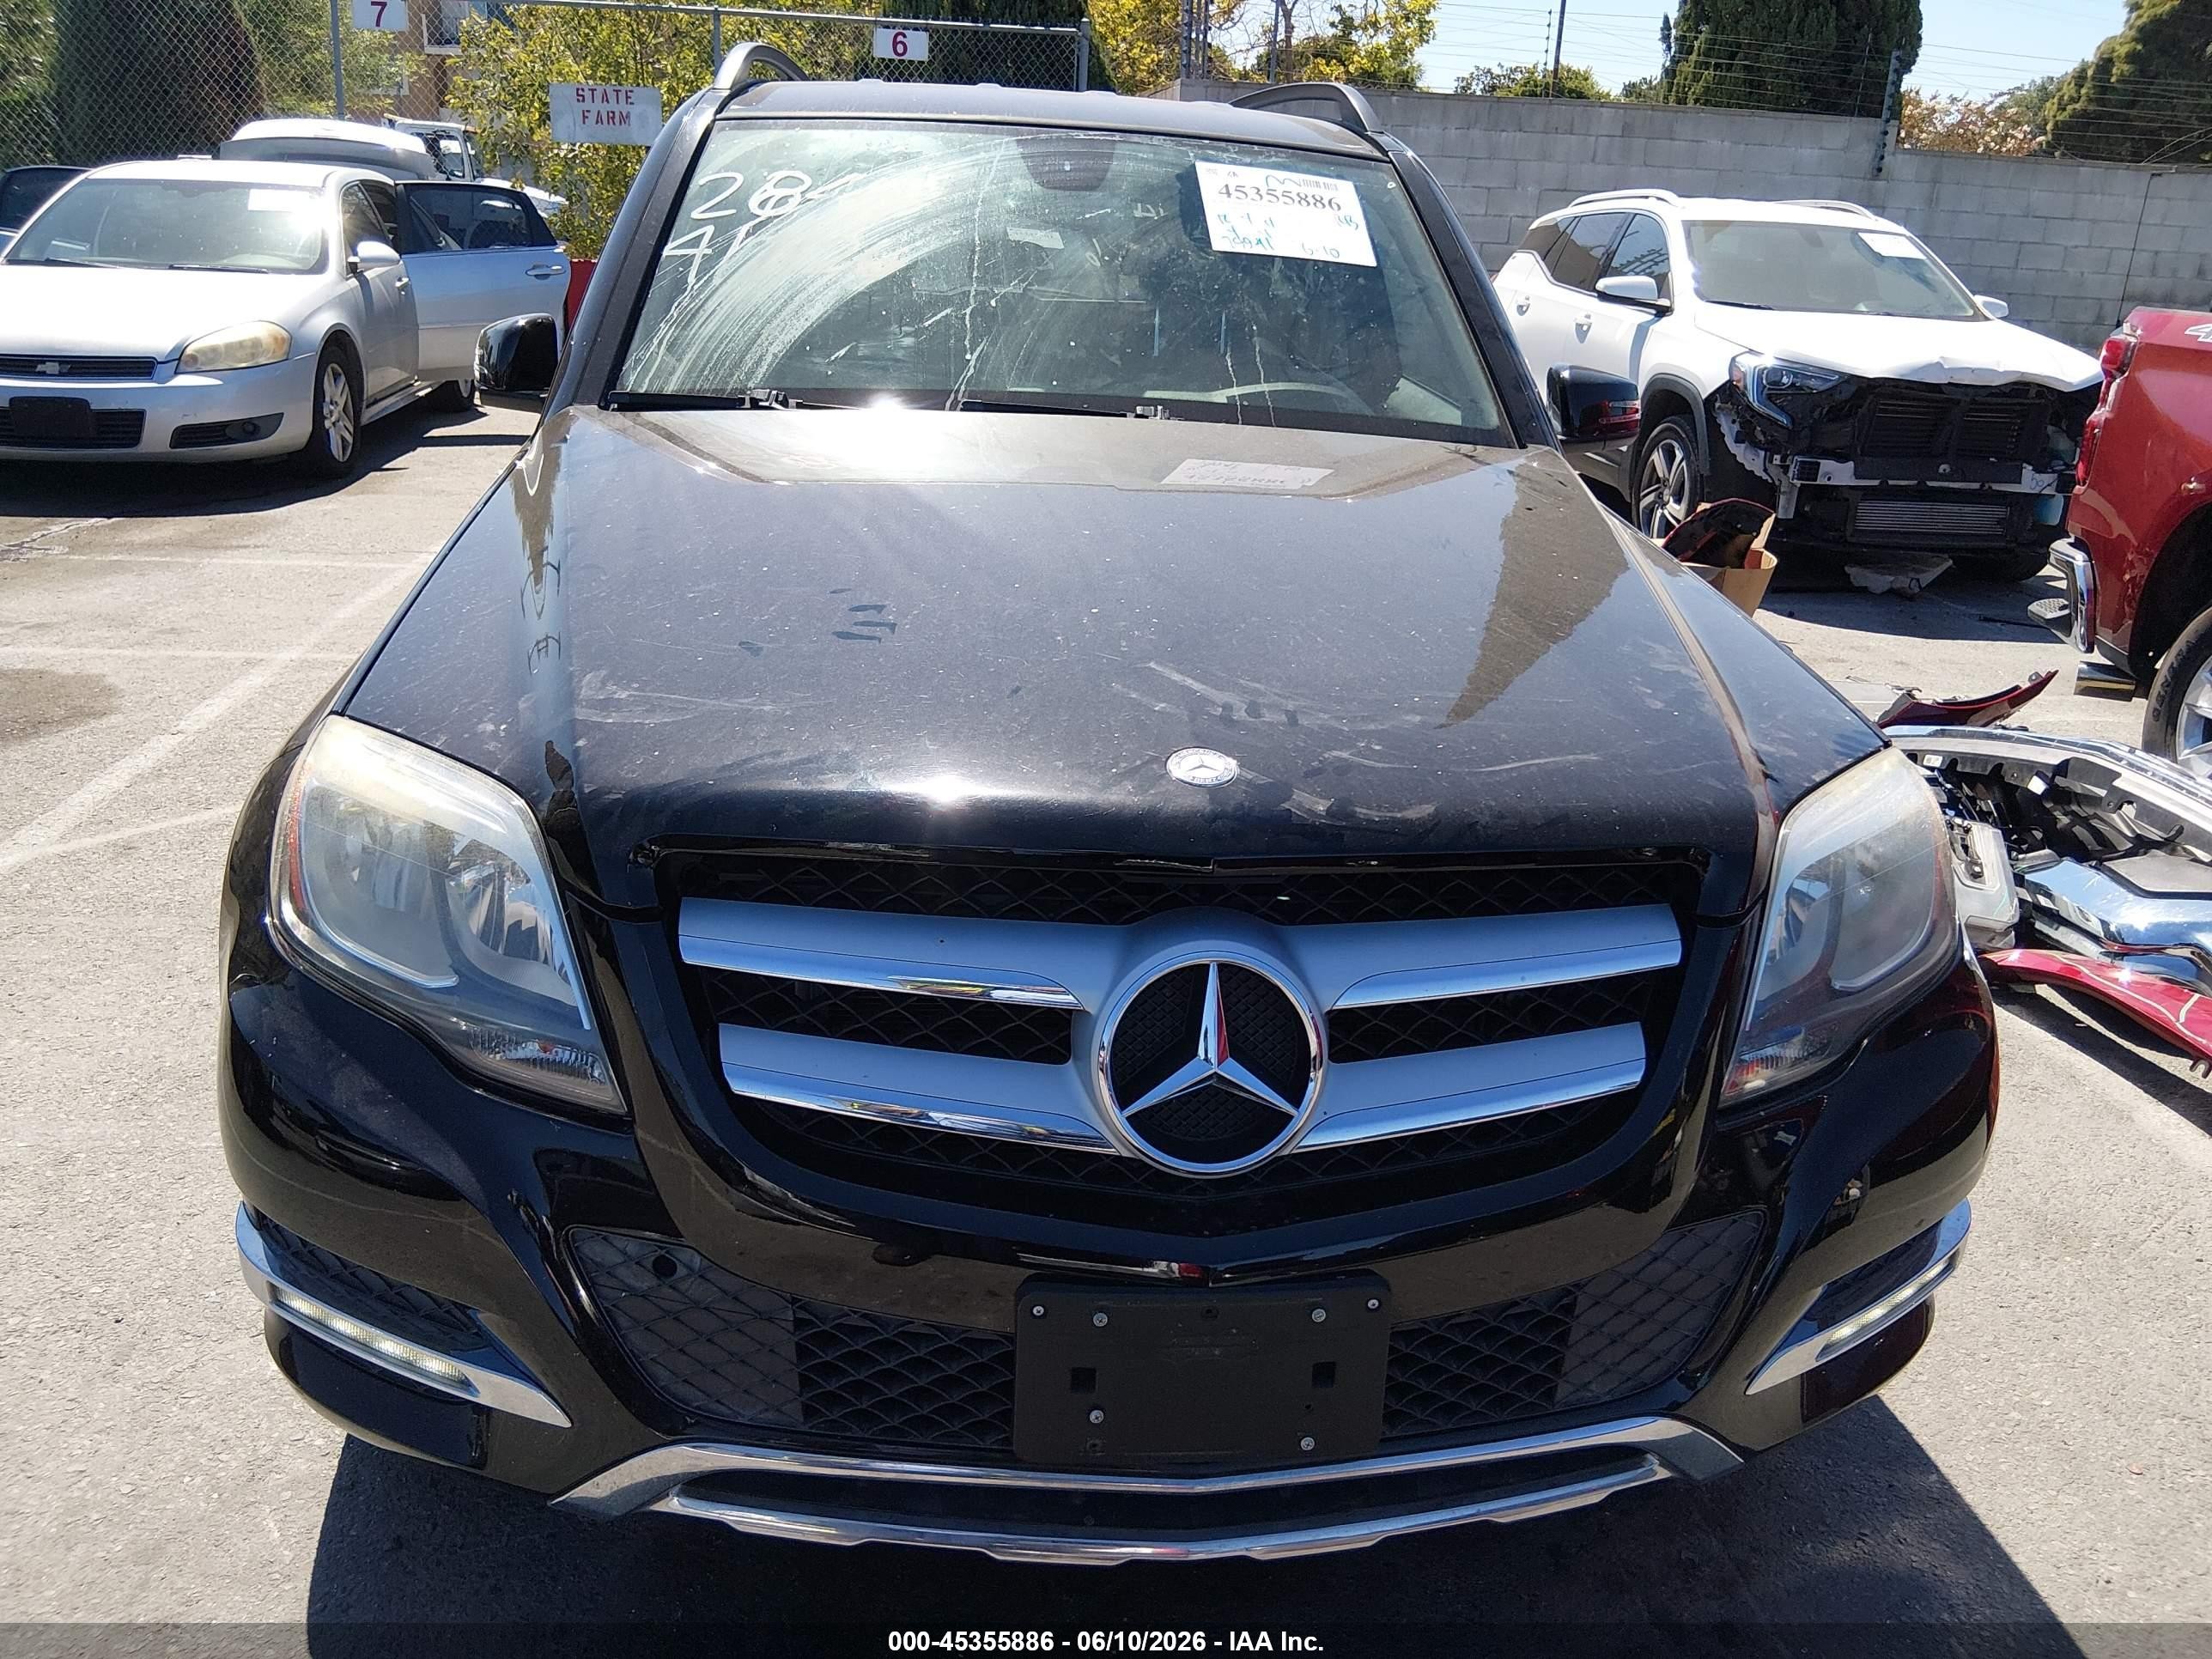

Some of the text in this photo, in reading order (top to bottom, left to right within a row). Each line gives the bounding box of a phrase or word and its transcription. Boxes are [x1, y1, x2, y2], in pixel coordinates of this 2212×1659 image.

[371, 1, 387, 27] 7
[892, 31, 908, 58] 6
[575, 88, 635, 106] STATE
[581, 109, 631, 127] FARM
[1218, 183, 1341, 212] 45355886
